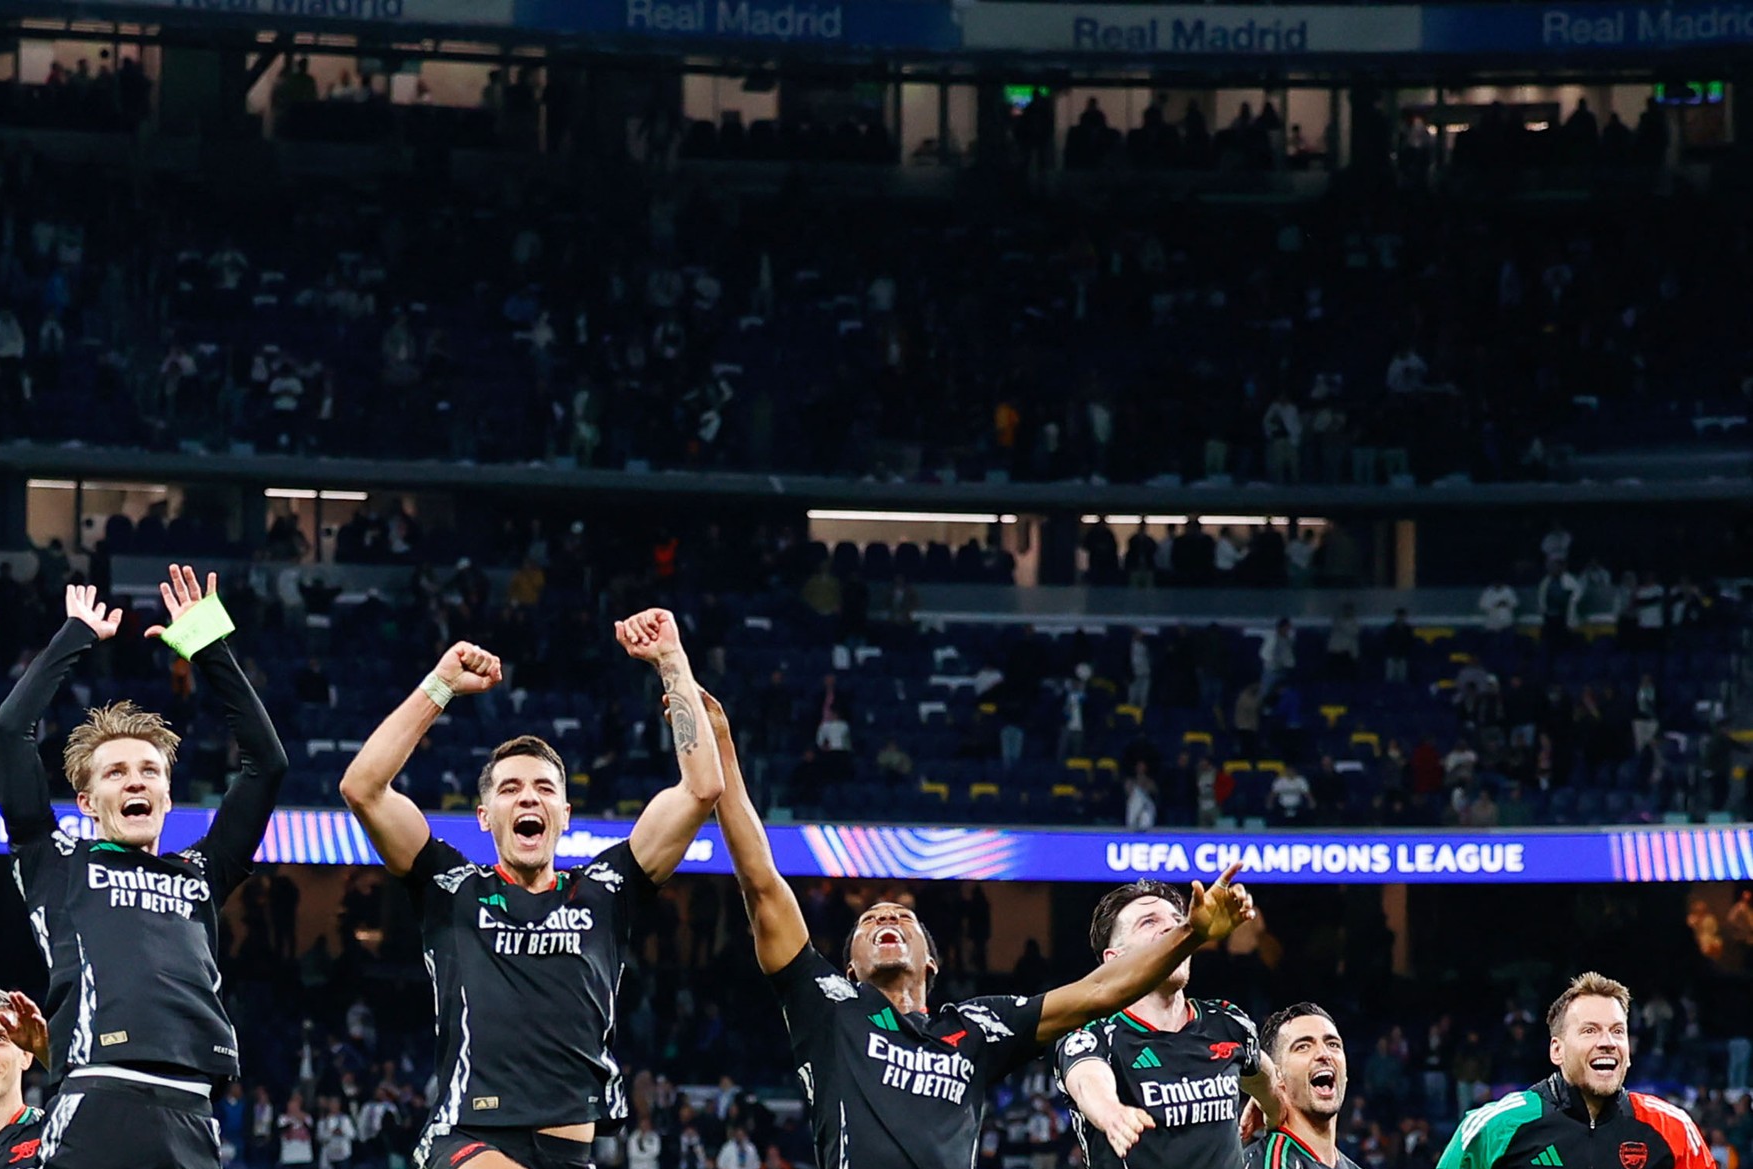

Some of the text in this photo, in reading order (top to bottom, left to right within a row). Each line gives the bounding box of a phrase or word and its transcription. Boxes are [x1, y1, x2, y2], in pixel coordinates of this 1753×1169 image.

[627, 0, 842, 38] Real Madrid
[1073, 17, 1308, 51] Real Madrid
[1542, 9, 1625, 44] Real
[1105, 842, 1526, 874] UEFA CHAMPIONS LEAGUE
[87, 862, 211, 902] Emirates
[110, 888, 194, 920] FLY BETTER
[494, 931, 583, 956] FLY BETTER
[867, 1031, 975, 1083] Emirate
[881, 1064, 967, 1106] FLY BETTER
[1139, 1072, 1240, 1108] Emirates
[1164, 1098, 1236, 1128] FLY BETTER
